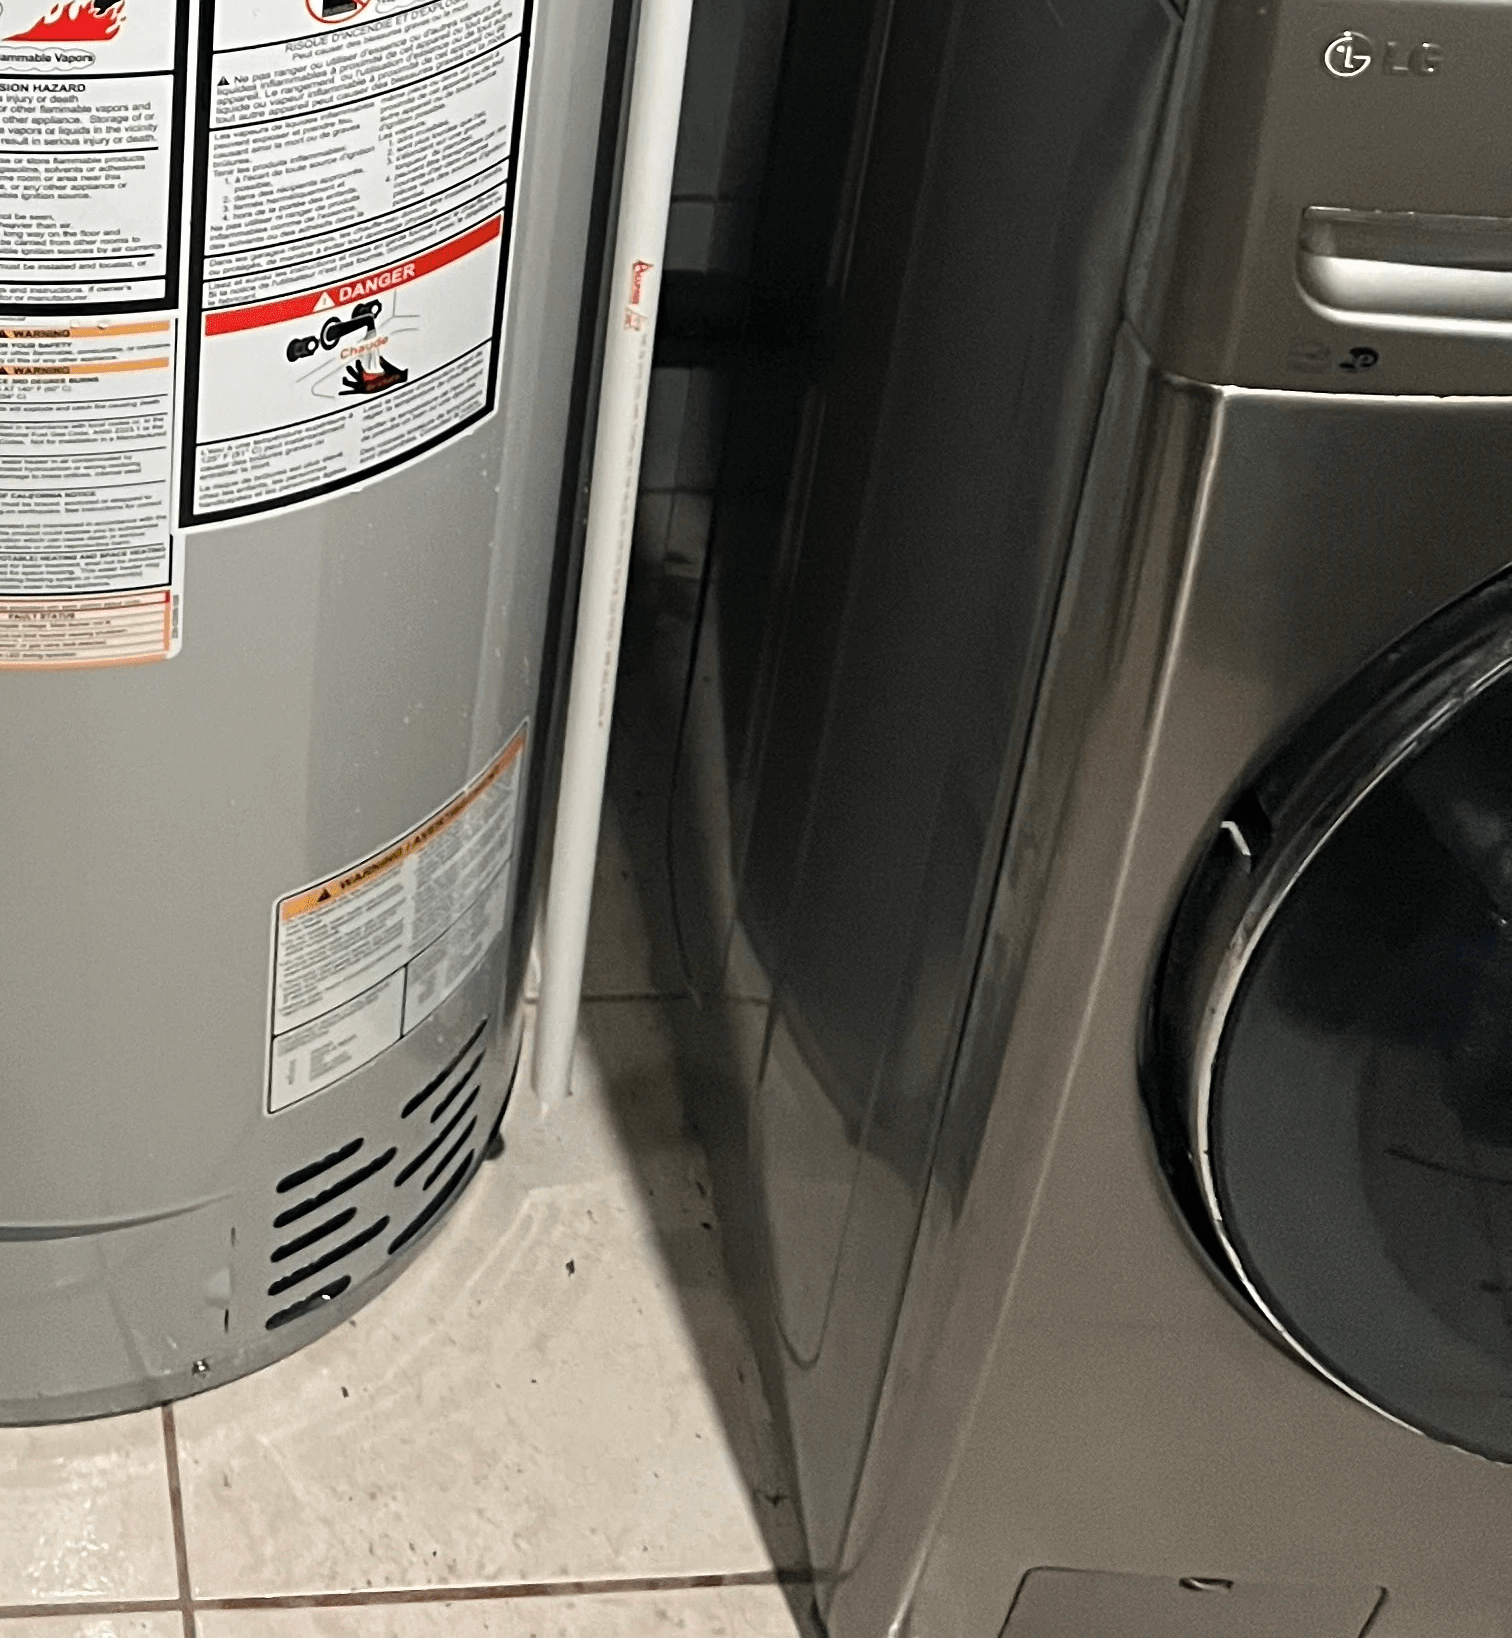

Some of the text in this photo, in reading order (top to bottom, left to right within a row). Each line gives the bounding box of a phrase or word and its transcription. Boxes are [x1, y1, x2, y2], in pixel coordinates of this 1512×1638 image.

[285, 38, 328, 52] RISQUE
[332, 18, 392, 44] D'INCENDIE
[395, 14, 408, 26] ET
[54, 52, 94, 64] Vapors
[1383, 40, 1443, 76] LG
[33, 82, 86, 93] HAZARD
[339, 263, 416, 302] DANGER
[12, 329, 70, 338] WARNING
[12, 366, 70, 374] WARNING
